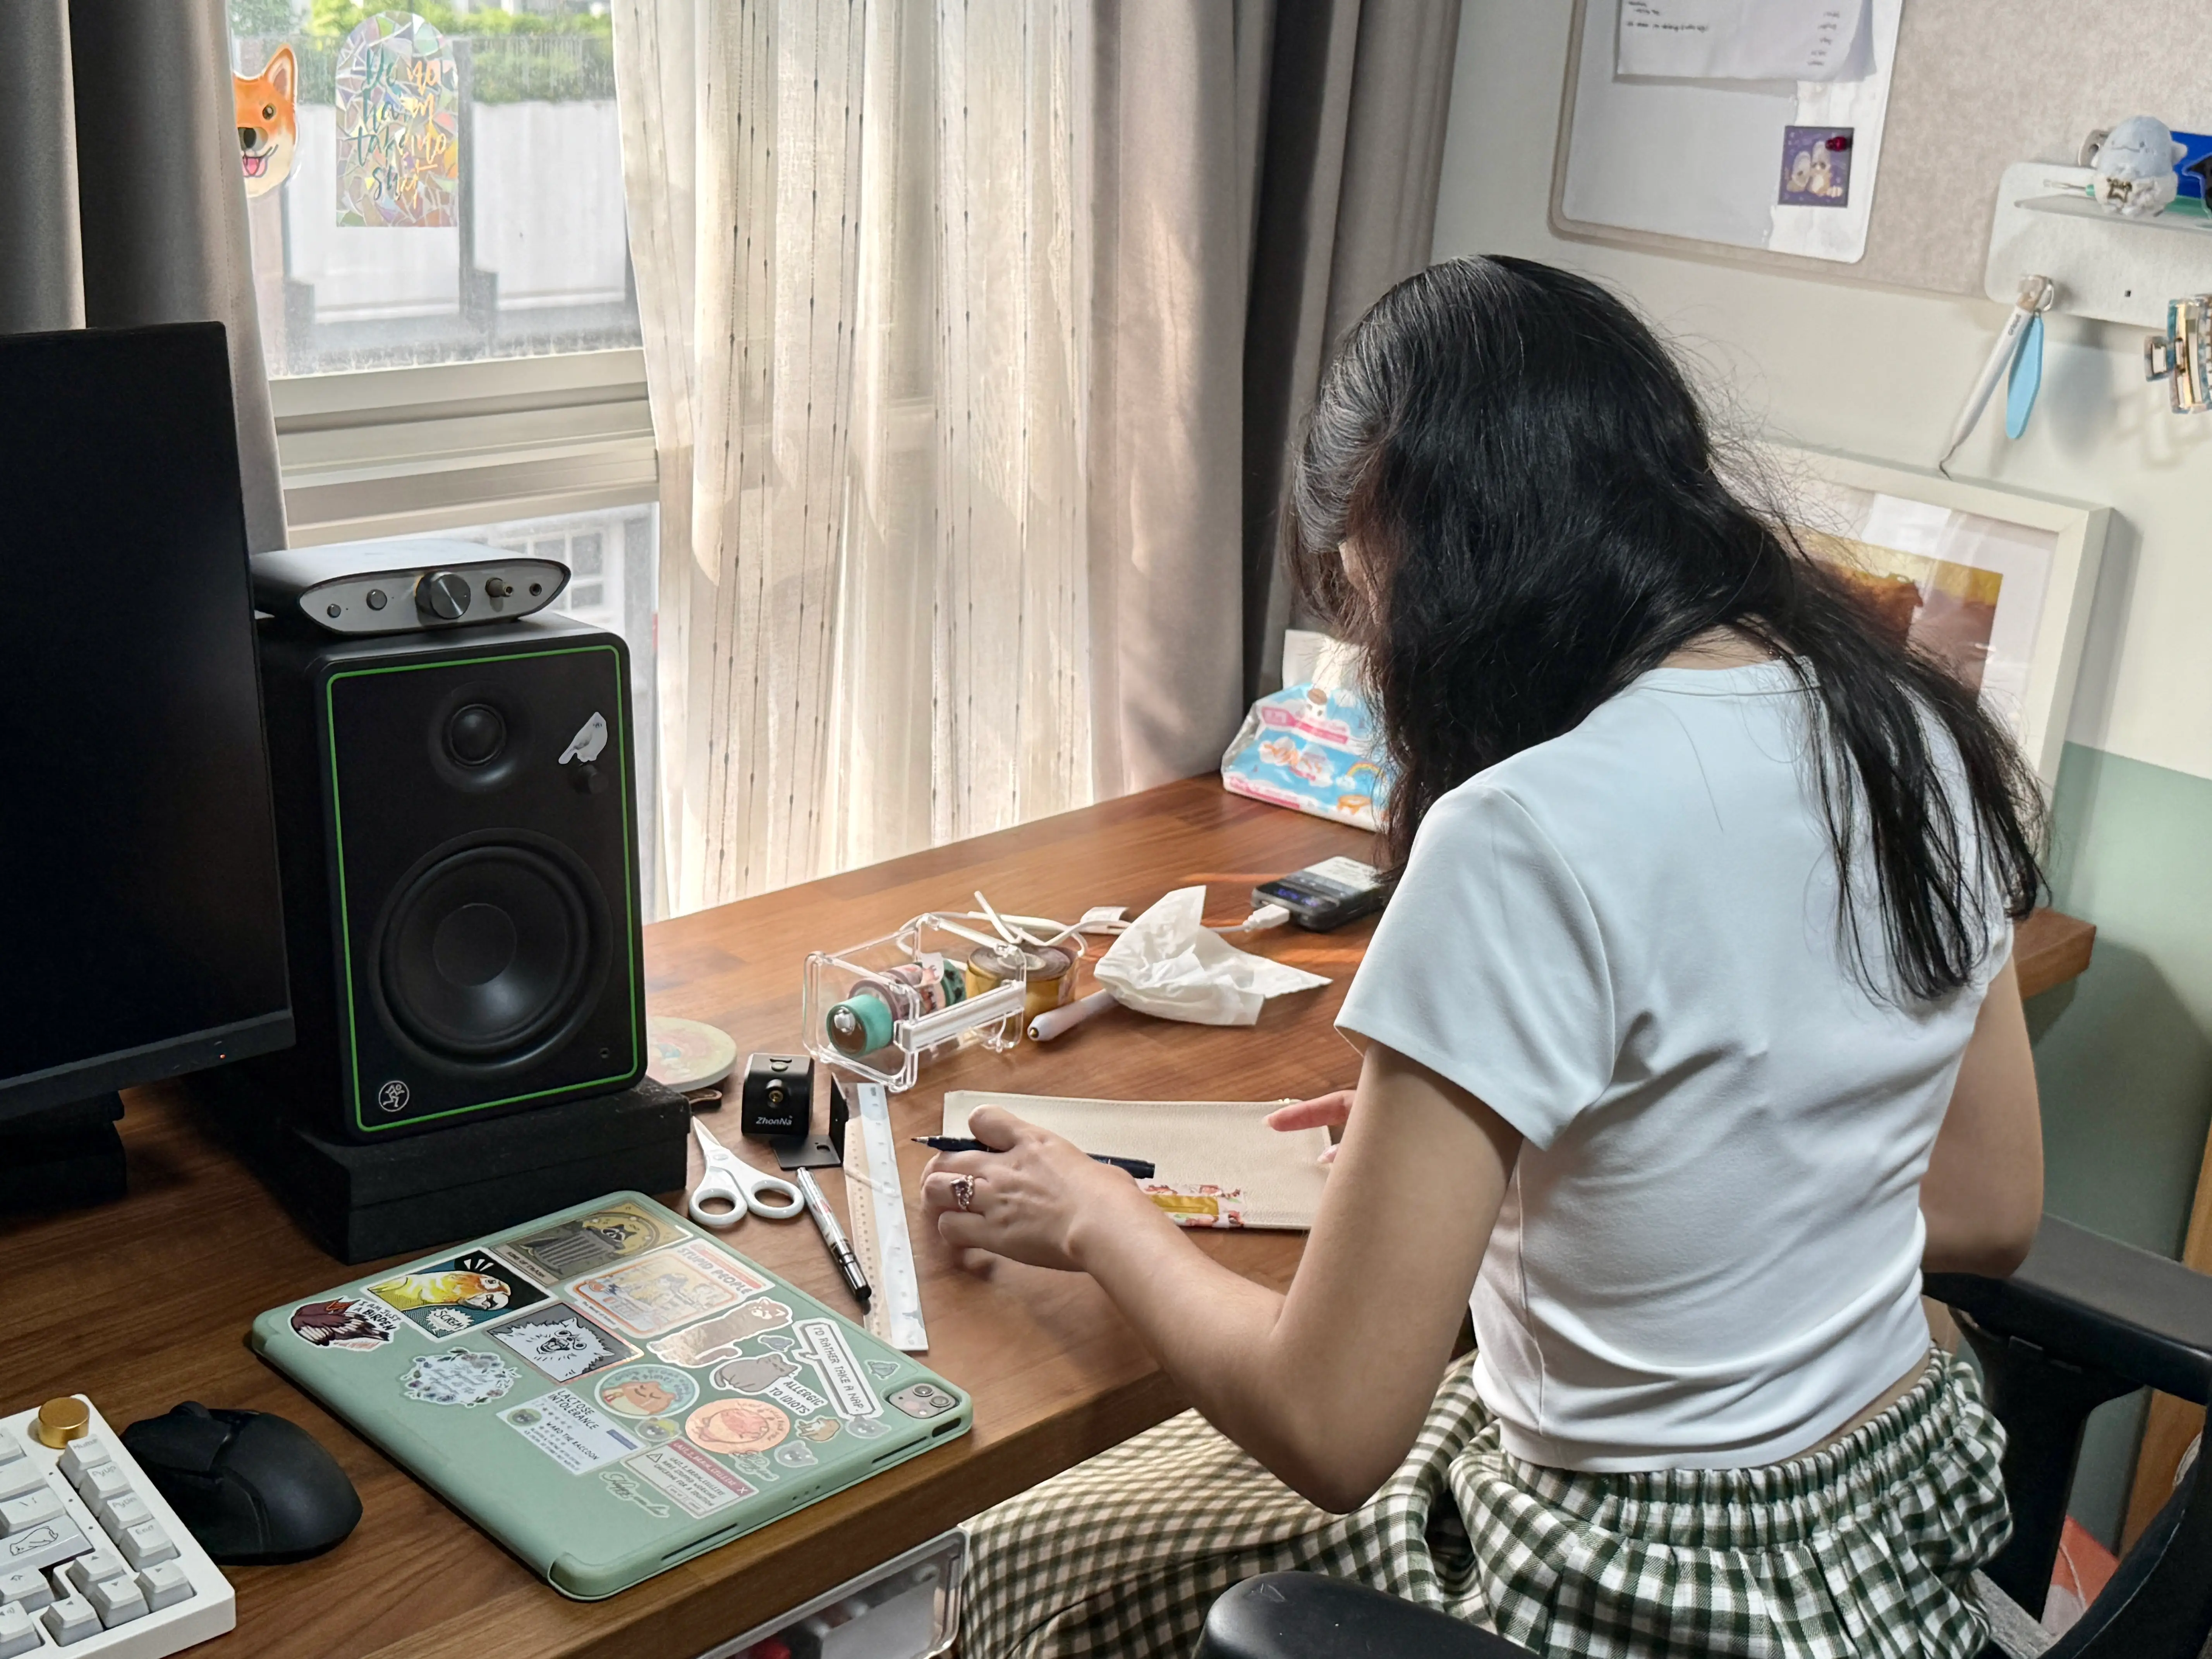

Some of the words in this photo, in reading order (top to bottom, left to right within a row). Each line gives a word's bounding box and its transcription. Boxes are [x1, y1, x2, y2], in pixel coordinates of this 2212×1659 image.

[677, 1248, 713, 1269] STUPID
[711, 1269, 753, 1294] PEOPLE
[362, 1309, 397, 1331] BIRDEN
[367, 1303, 382, 1311] AM
[381, 1309, 402, 1321] JUST
[819, 1337, 840, 1364] RATHER
[833, 1366, 851, 1384] TAKE
[556, 1390, 595, 1415] LACTOSE
[769, 1387, 784, 1396] TO
[780, 1395, 810, 1414] IDIOTS
[783, 1381, 824, 1406] ALLERGIC
[547, 1394, 599, 1430] INTOLERANCE
[562, 1433, 574, 1441] THE
[572, 1441, 600, 1460] RACCOON
[135, 1525, 154, 1534] End
